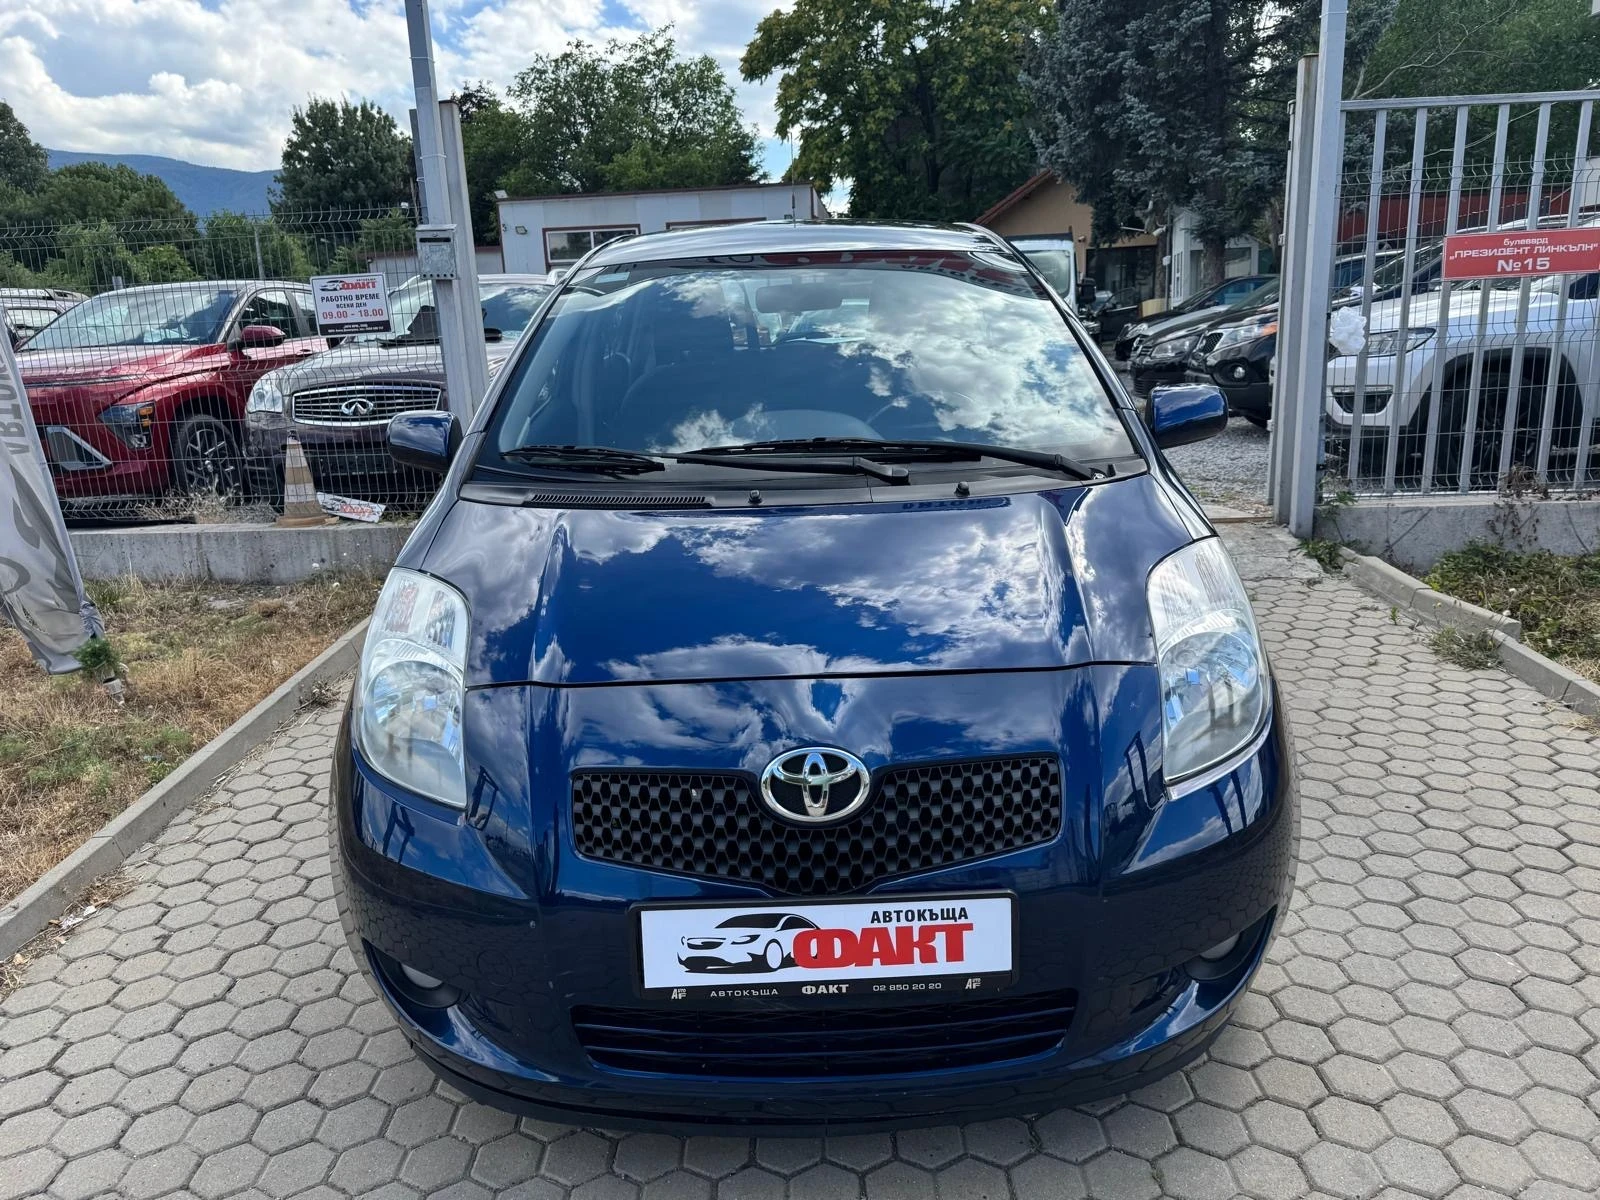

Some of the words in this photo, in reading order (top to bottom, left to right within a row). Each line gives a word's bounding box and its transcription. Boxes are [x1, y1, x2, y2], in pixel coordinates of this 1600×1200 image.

[320, 294, 353, 303] РАБОТНО
[355, 293, 380, 301] ВРЕМЕ
[322, 310, 348, 319] 09.00
[358, 308, 384, 318] 18.00
[869, 906, 970, 925] АВТОКЪЩА
[792, 922, 974, 969] ФАКТ
[801, 983, 850, 995] ФАКТ
[872, 983, 887, 991] 02
[889, 982, 910, 991] 850
[912, 982, 927, 990] 20
[928, 981, 942, 990] 20
